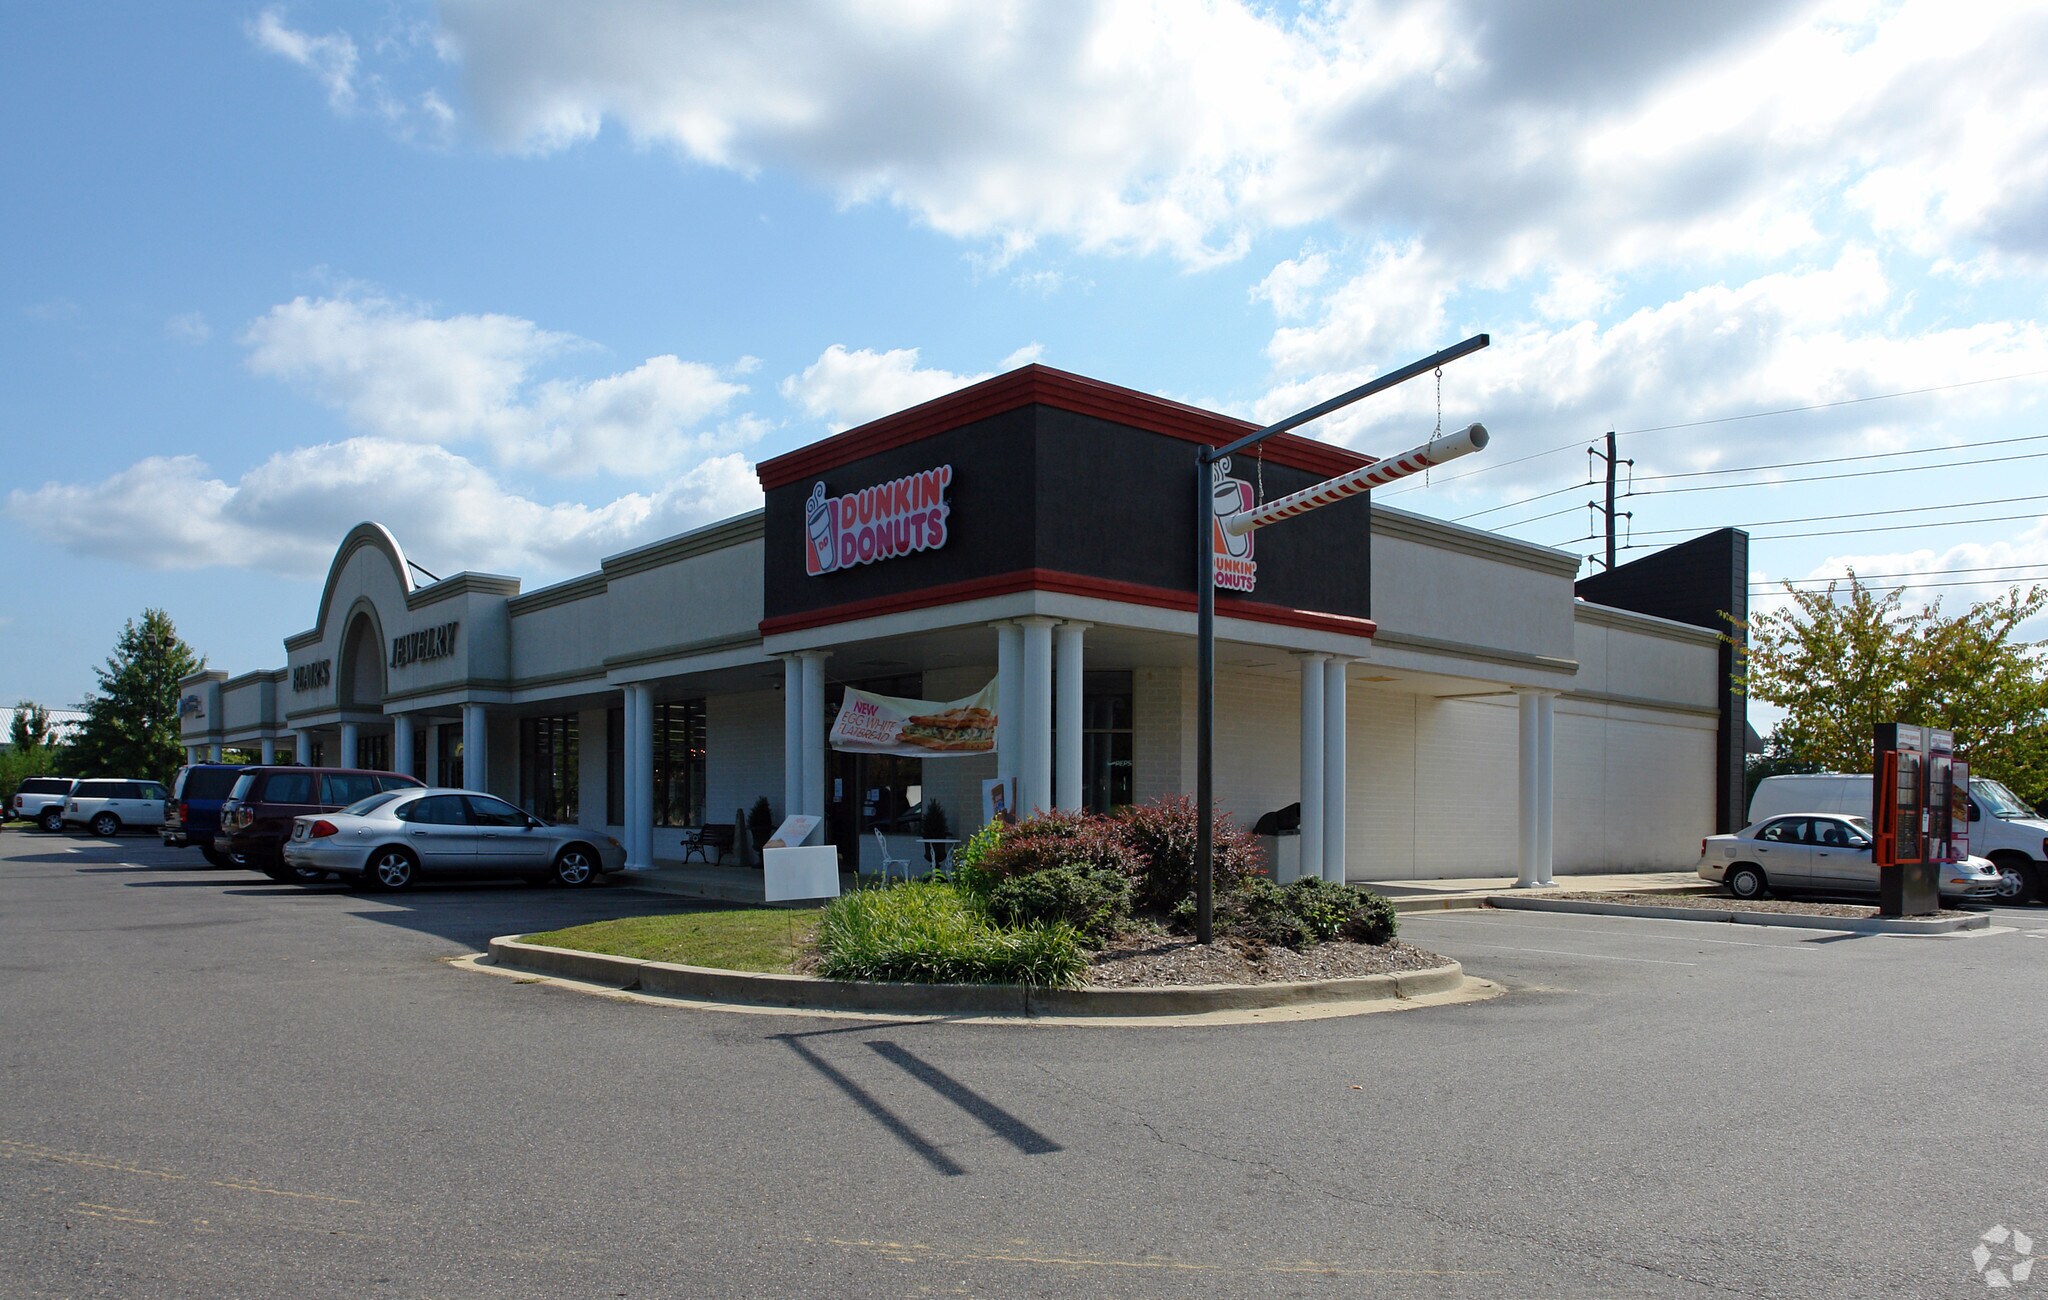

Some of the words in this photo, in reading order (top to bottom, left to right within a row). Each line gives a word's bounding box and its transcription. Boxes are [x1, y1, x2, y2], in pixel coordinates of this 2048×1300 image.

[842, 467, 948, 529] DUNKIN'
[841, 508, 944, 566] DONUTS
[1214, 557, 1255, 575] UNKIN'
[1214, 571, 1253, 590] ONUTS
[390, 621, 459, 669] JEWELRY
[854, 701, 878, 716] NEW
[842, 711, 864, 726] EGG
[866, 716, 897, 732] WHITE
